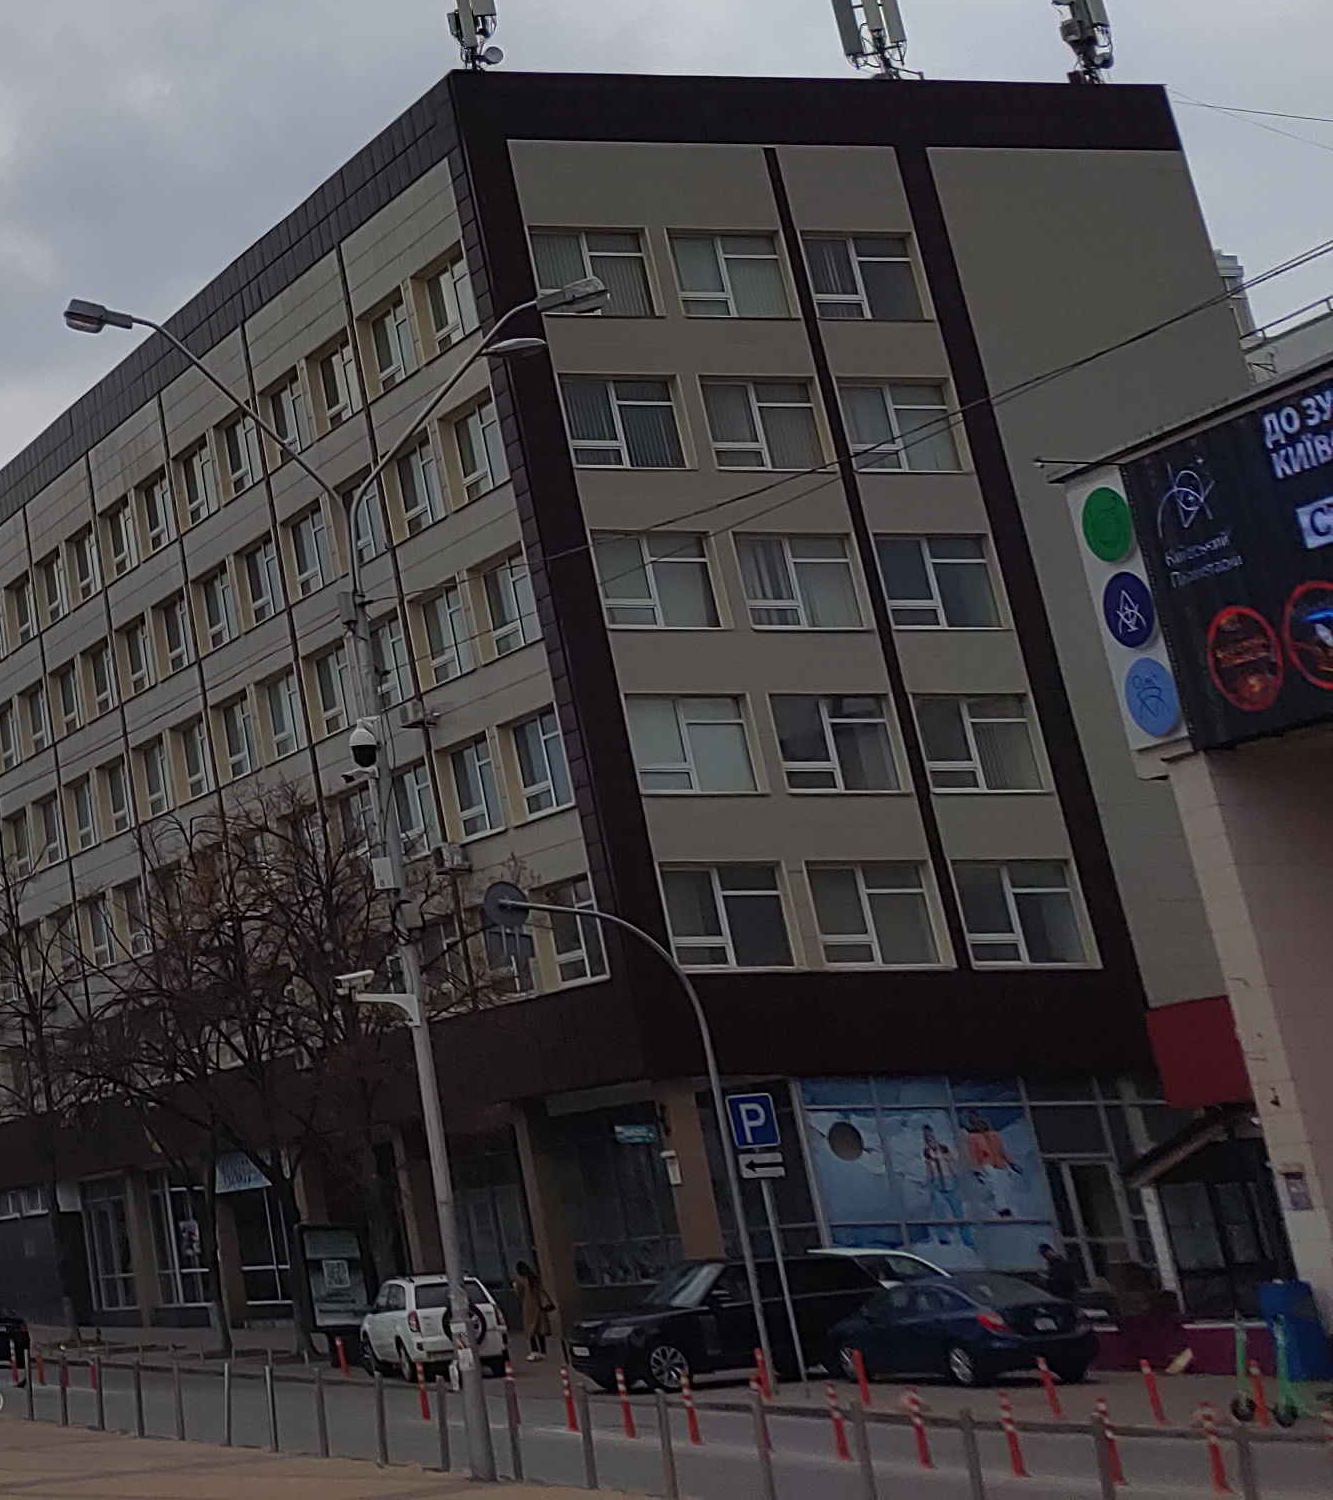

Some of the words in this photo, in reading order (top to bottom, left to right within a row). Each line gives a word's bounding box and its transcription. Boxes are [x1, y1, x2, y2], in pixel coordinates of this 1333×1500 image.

[1262, 406, 1301, 449] ДО
[1270, 432, 1333, 480] КИЇВ
[738, 1102, 766, 1144] P
